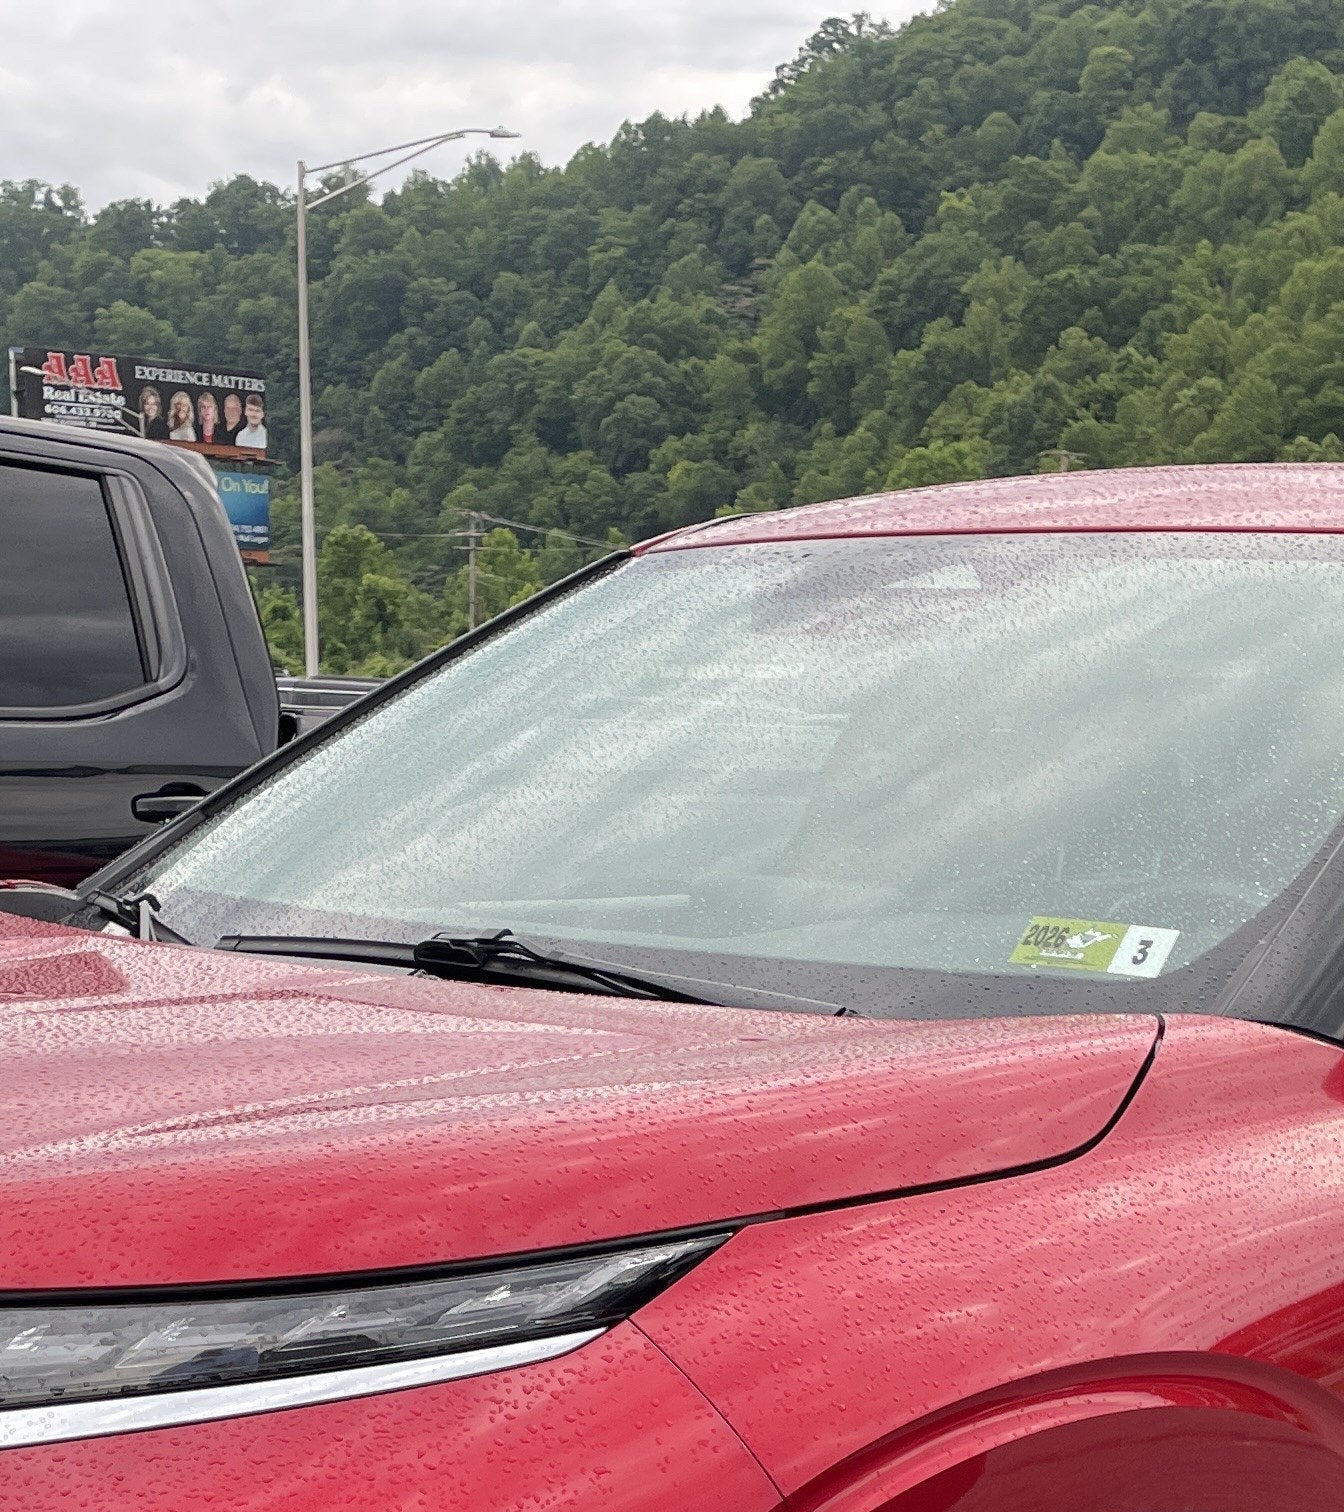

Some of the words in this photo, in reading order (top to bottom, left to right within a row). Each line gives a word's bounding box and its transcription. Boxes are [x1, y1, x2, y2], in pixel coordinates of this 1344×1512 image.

[42, 352, 123, 390] AAA
[135, 366, 209, 386] EXPERIENCE
[211, 373, 265, 392] MATTERS
[43, 386, 76, 402] Real
[221, 476, 241, 493] On
[1021, 923, 1071, 948] 2026
[1131, 940, 1154, 966] 3
